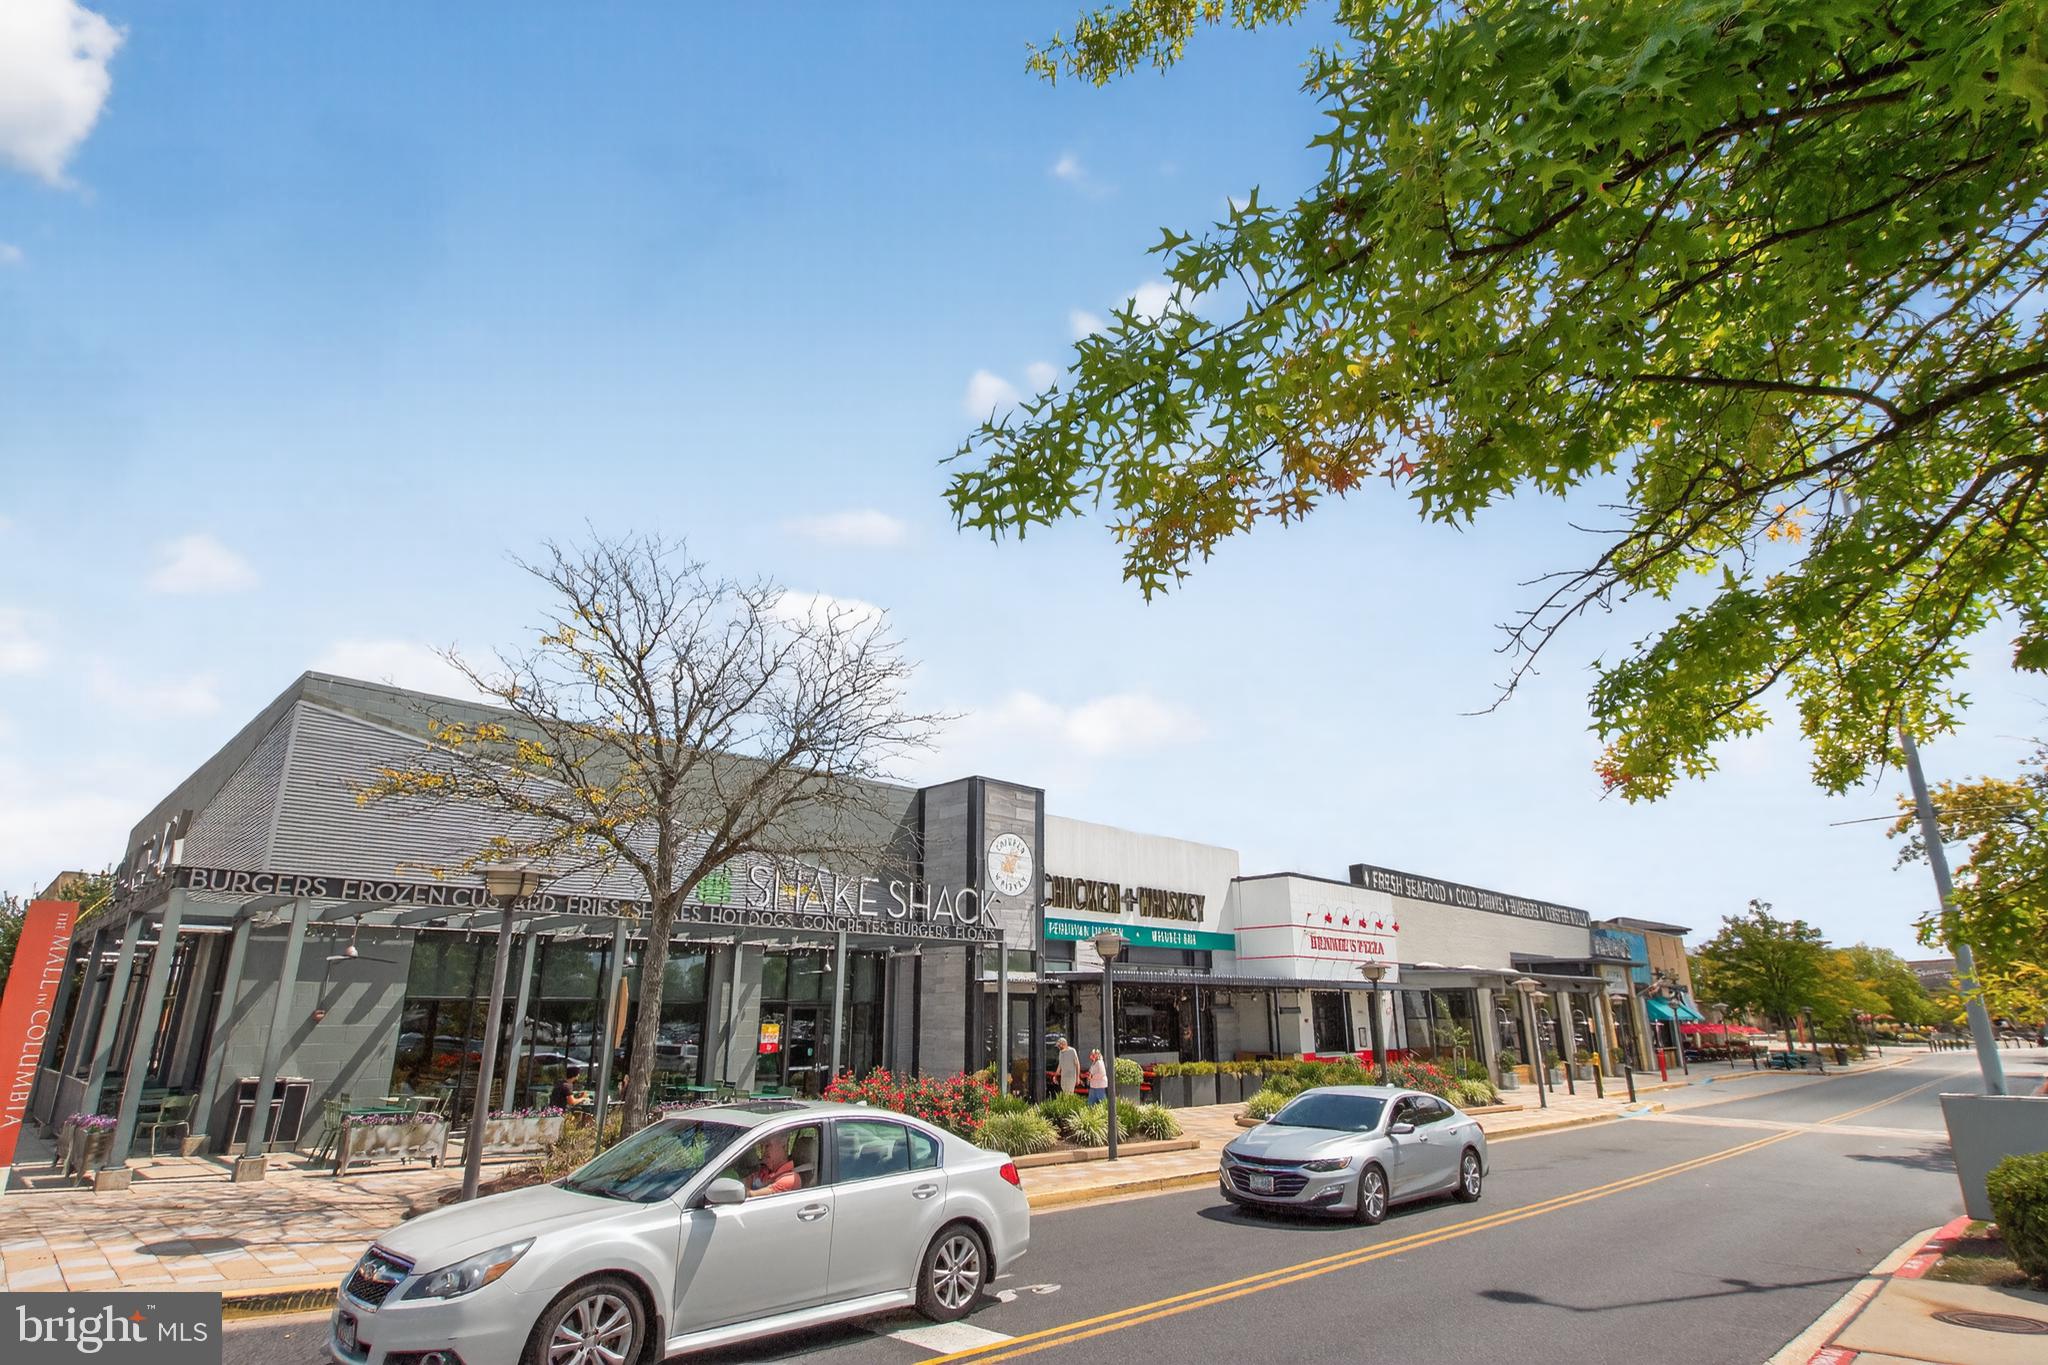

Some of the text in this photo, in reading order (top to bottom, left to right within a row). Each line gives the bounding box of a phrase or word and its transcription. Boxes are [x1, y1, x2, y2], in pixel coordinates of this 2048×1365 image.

[188, 868, 328, 898] BURGERS
[341, 880, 446, 906] FROZEN
[453, 888, 556, 912] CUSARD
[567, 896, 620, 917] FRIES
[631, 901, 702, 922] SHES
[710, 908, 747, 925] HOT
[749, 911, 794, 929] DOGS
[802, 915, 887, 934] CONCRETES
[748, 866, 998, 927] SHAKE SHACK
[1137, 886, 1206, 923] WHISKEY
[1372, 871, 1403, 895] FRESH
[1405, 878, 1446, 902] SEAFOOD
[1456, 887, 1477, 907] COLD
[39, 935, 72, 985] MALL
[0, 1009, 52, 1129] COLUMBIA
